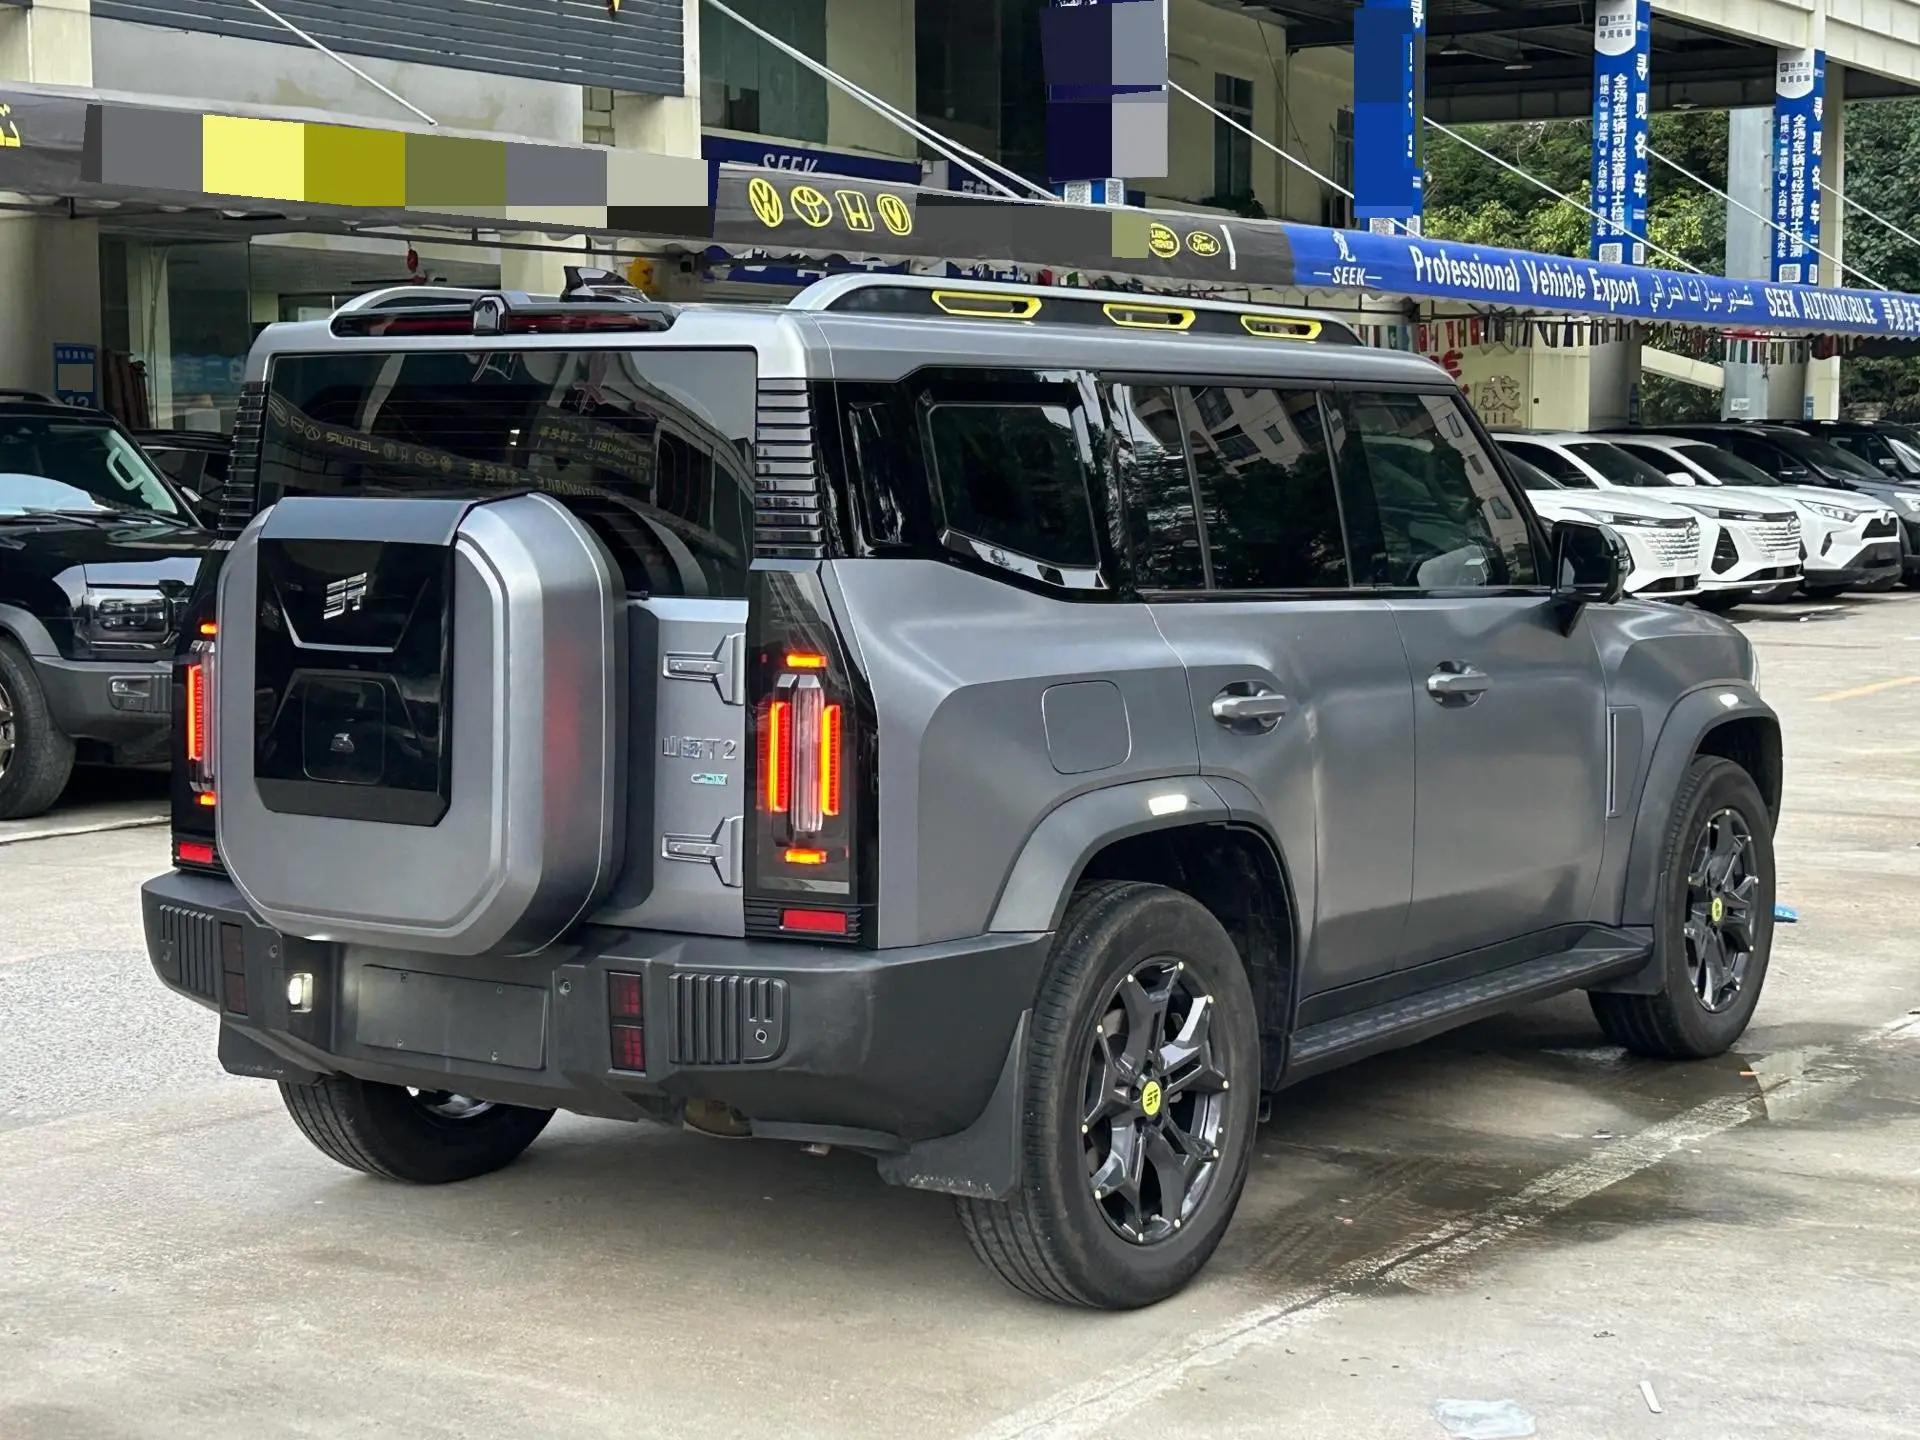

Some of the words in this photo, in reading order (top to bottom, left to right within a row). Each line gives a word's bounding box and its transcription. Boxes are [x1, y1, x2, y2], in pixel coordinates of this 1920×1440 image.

[1332, 266, 1366, 287] SEEK
[1409, 246, 1520, 293] Professional
[1523, 260, 1585, 299] Vehicle
[1588, 268, 1640, 310] Export
[1765, 287, 1800, 319] SEEK
[1800, 292, 1877, 325] AUTOMOBILE
